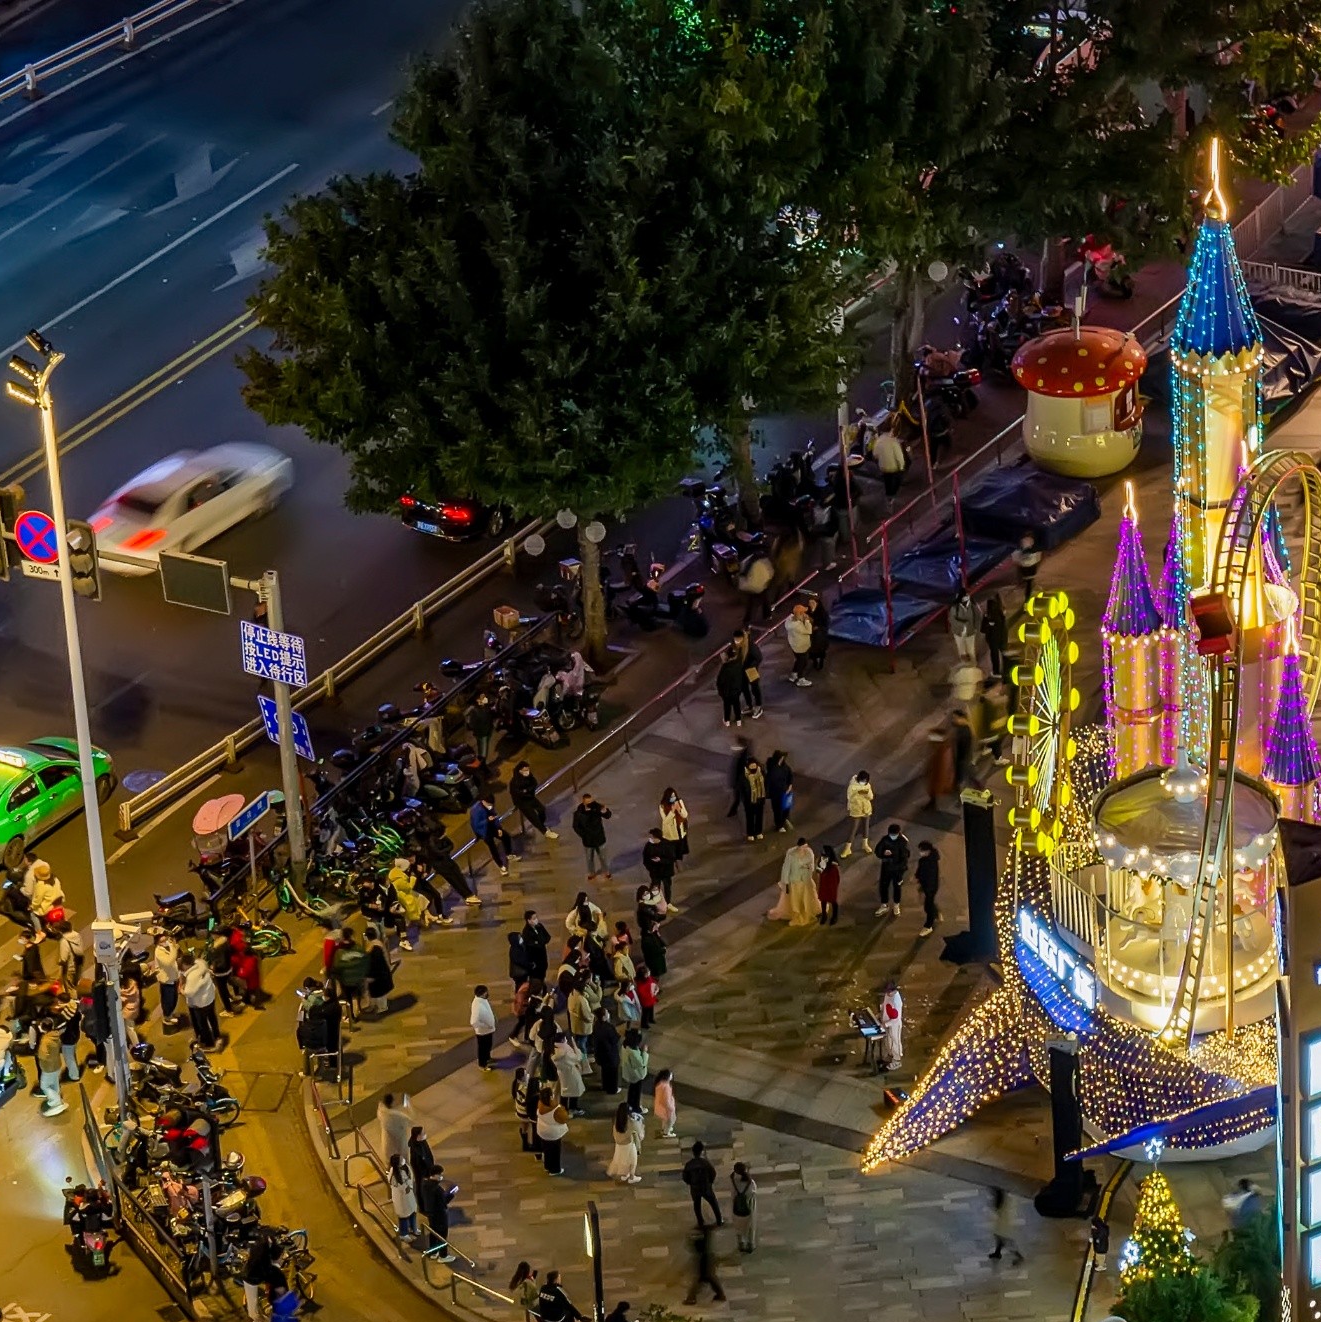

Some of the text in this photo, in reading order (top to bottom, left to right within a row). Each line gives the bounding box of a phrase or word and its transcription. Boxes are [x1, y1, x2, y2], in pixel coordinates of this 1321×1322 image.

[29, 564, 50, 576] 300m
[243, 624, 303, 654] 停止线等待
[244, 640, 305, 670] 按LED提示
[245, 656, 306, 686] 进入待行区
